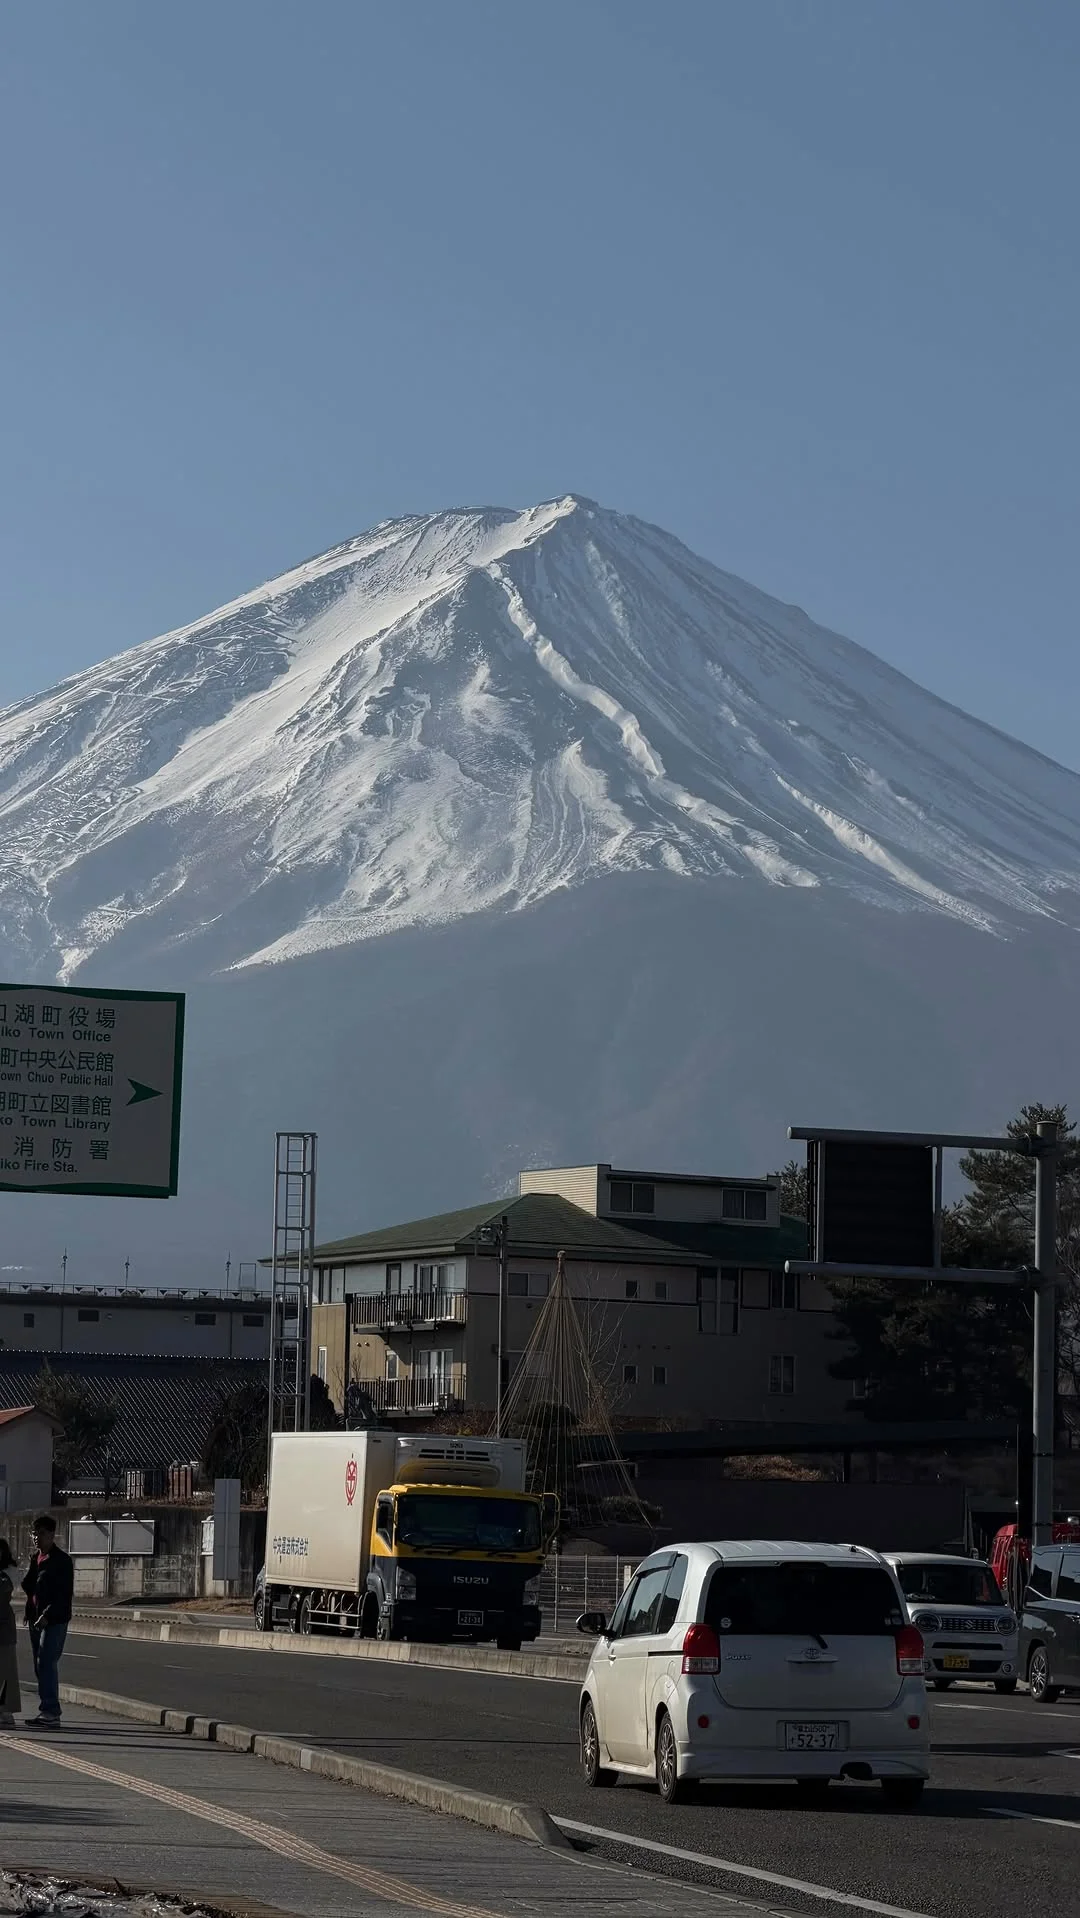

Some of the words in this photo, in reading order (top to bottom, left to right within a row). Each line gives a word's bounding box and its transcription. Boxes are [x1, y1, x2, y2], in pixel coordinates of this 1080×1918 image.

[28, 1027, 64, 1040] Town
[72, 1029, 112, 1042] Office
[0, 1047, 114, 1073] 町中央公民館
[0, 1070, 21, 1083] own
[27, 1071, 55, 1083] Chuo
[60, 1072, 91, 1085] Public
[94, 1074, 113, 1087] Hall
[21, 1115, 57, 1128] Town
[64, 1117, 110, 1132] Library
[14, 1135, 110, 1160] 消防署
[24, 1159, 49, 1171] Fire
[53, 1161, 78, 1173] Sta.
[453, 1576, 489, 1584] ISUZU
[798, 1734, 835, 1748] 52-37
